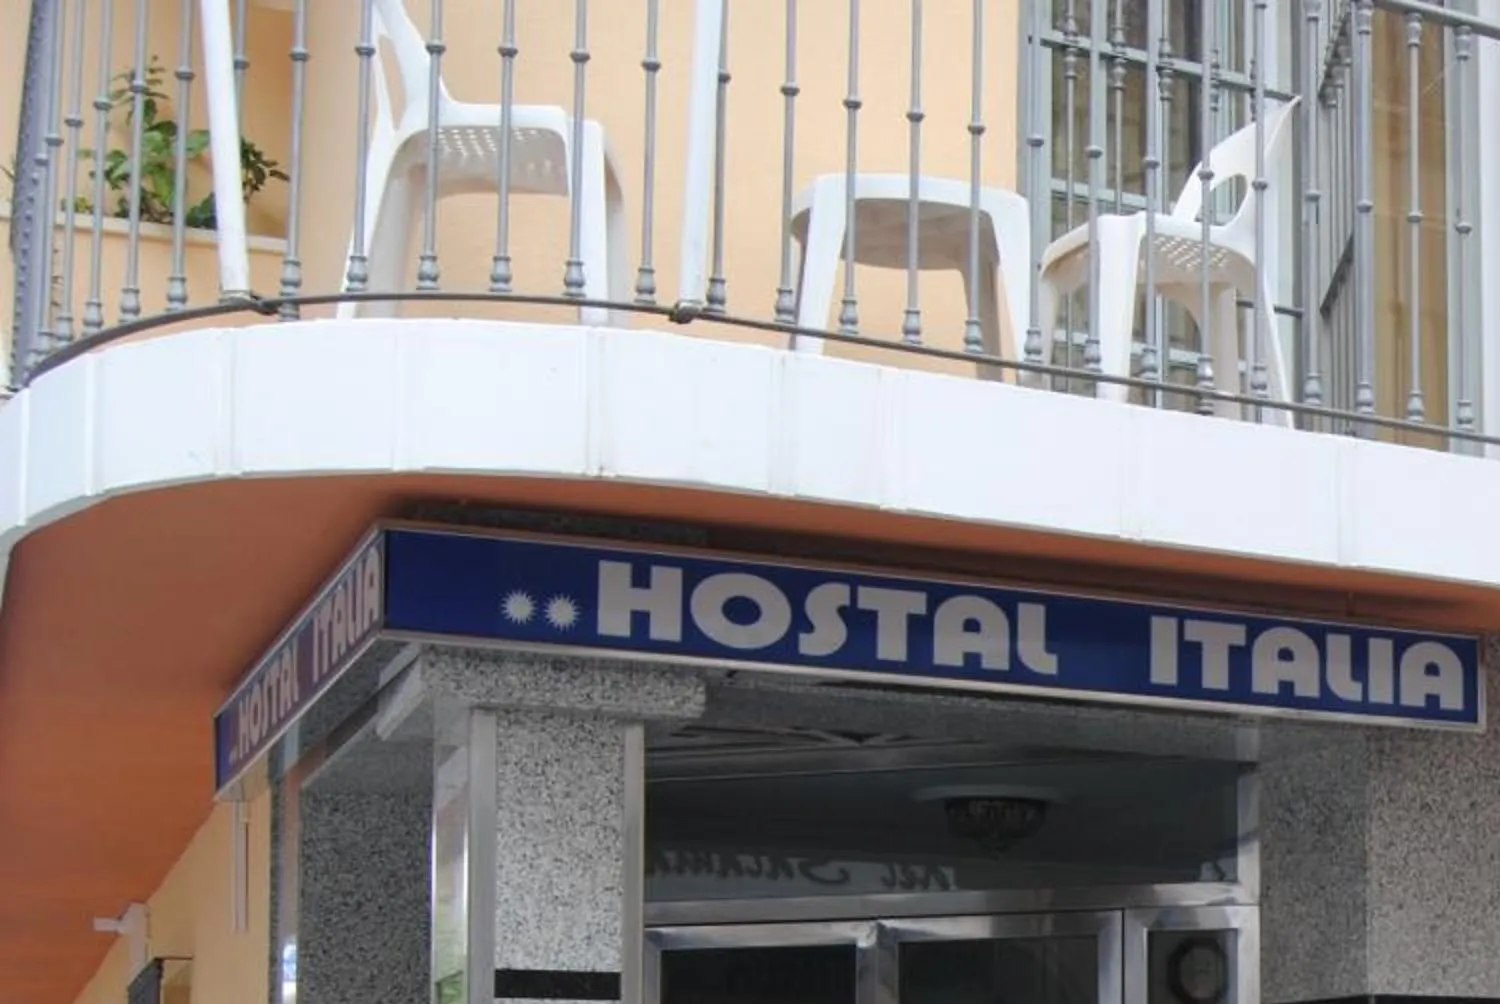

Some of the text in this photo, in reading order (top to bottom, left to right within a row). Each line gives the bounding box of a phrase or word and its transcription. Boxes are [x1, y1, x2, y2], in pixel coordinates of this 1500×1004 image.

[312, 546, 381, 684] ITALIA
[597, 560, 1465, 712] HOSTAL ITALIA
